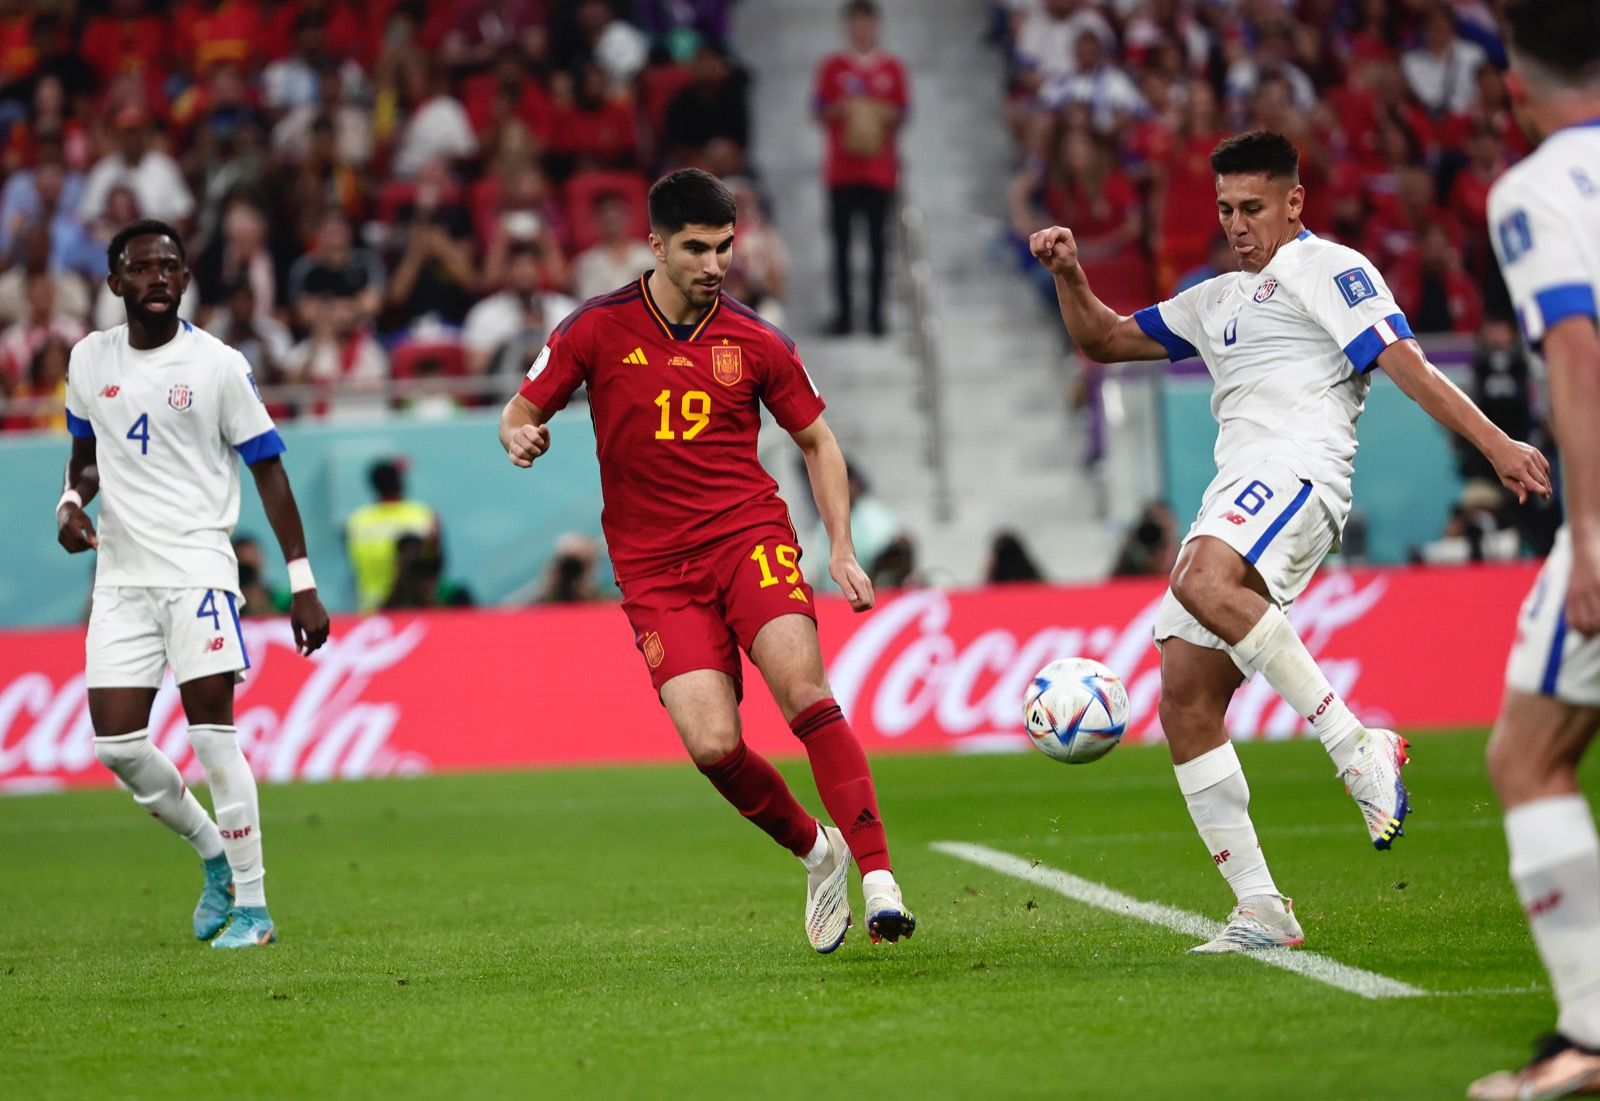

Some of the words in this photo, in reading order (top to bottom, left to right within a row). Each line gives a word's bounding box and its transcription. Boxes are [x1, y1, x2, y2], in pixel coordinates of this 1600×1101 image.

[126, 412, 150, 455] 4
[654, 389, 711, 440] 19
[1234, 480, 1274, 516] 6
[751, 543, 801, 588] 19
[196, 588, 220, 630] 4
[1307, 692, 1335, 724] FCRF
